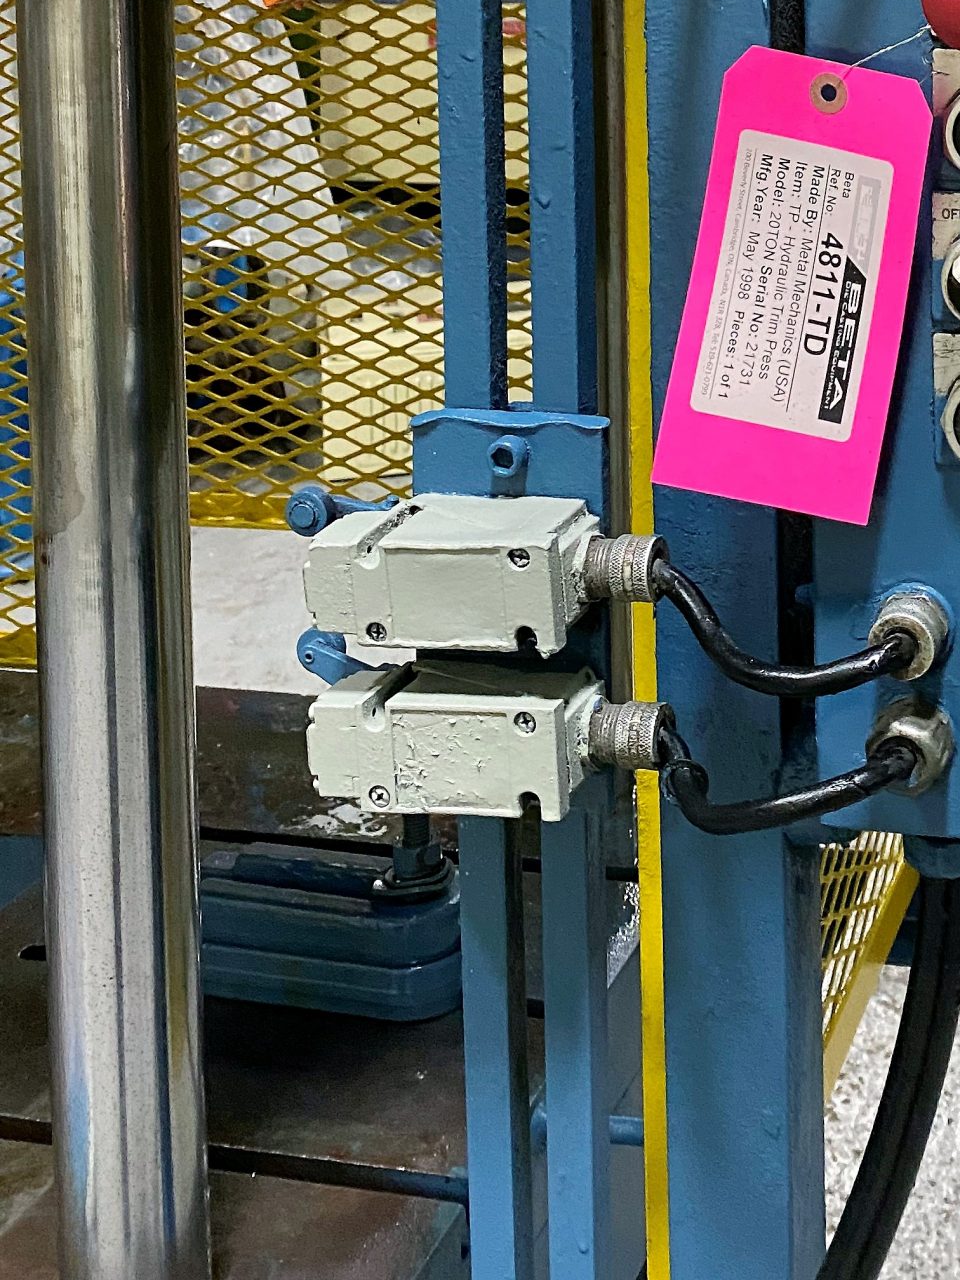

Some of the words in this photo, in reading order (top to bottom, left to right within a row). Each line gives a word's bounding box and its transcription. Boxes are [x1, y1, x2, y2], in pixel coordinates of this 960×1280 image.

[771, 156, 791, 208] Model:
[790, 160, 808, 198] Item:
[807, 164, 825, 206] Made
[827, 167, 841, 193] Ref.
[840, 170, 855, 199] Beta
[787, 201, 802, 224] TP
[800, 208, 818, 234] By:
[824, 194, 836, 216] No:
[741, 230, 760, 262] May
[762, 210, 782, 262] 20TON
[795, 237, 814, 277] Metal
[736, 265, 754, 301] 1998
[753, 264, 773, 309] Serial
[772, 234, 796, 302] Hydraulic
[801, 230, 846, 358] 4811-TD
[725, 309, 745, 359] Pieces:
[747, 311, 764, 339] No:
[766, 303, 784, 336] Trim
[781, 279, 806, 356] Mechanics
[738, 340, 758, 386] 21731
[757, 338, 778, 381] Press
[828, 281, 863, 412] BETA
[719, 372, 733, 389] of
[769, 357, 792, 404] (USA)
[822, 349, 840, 409] EQUIPMENT
